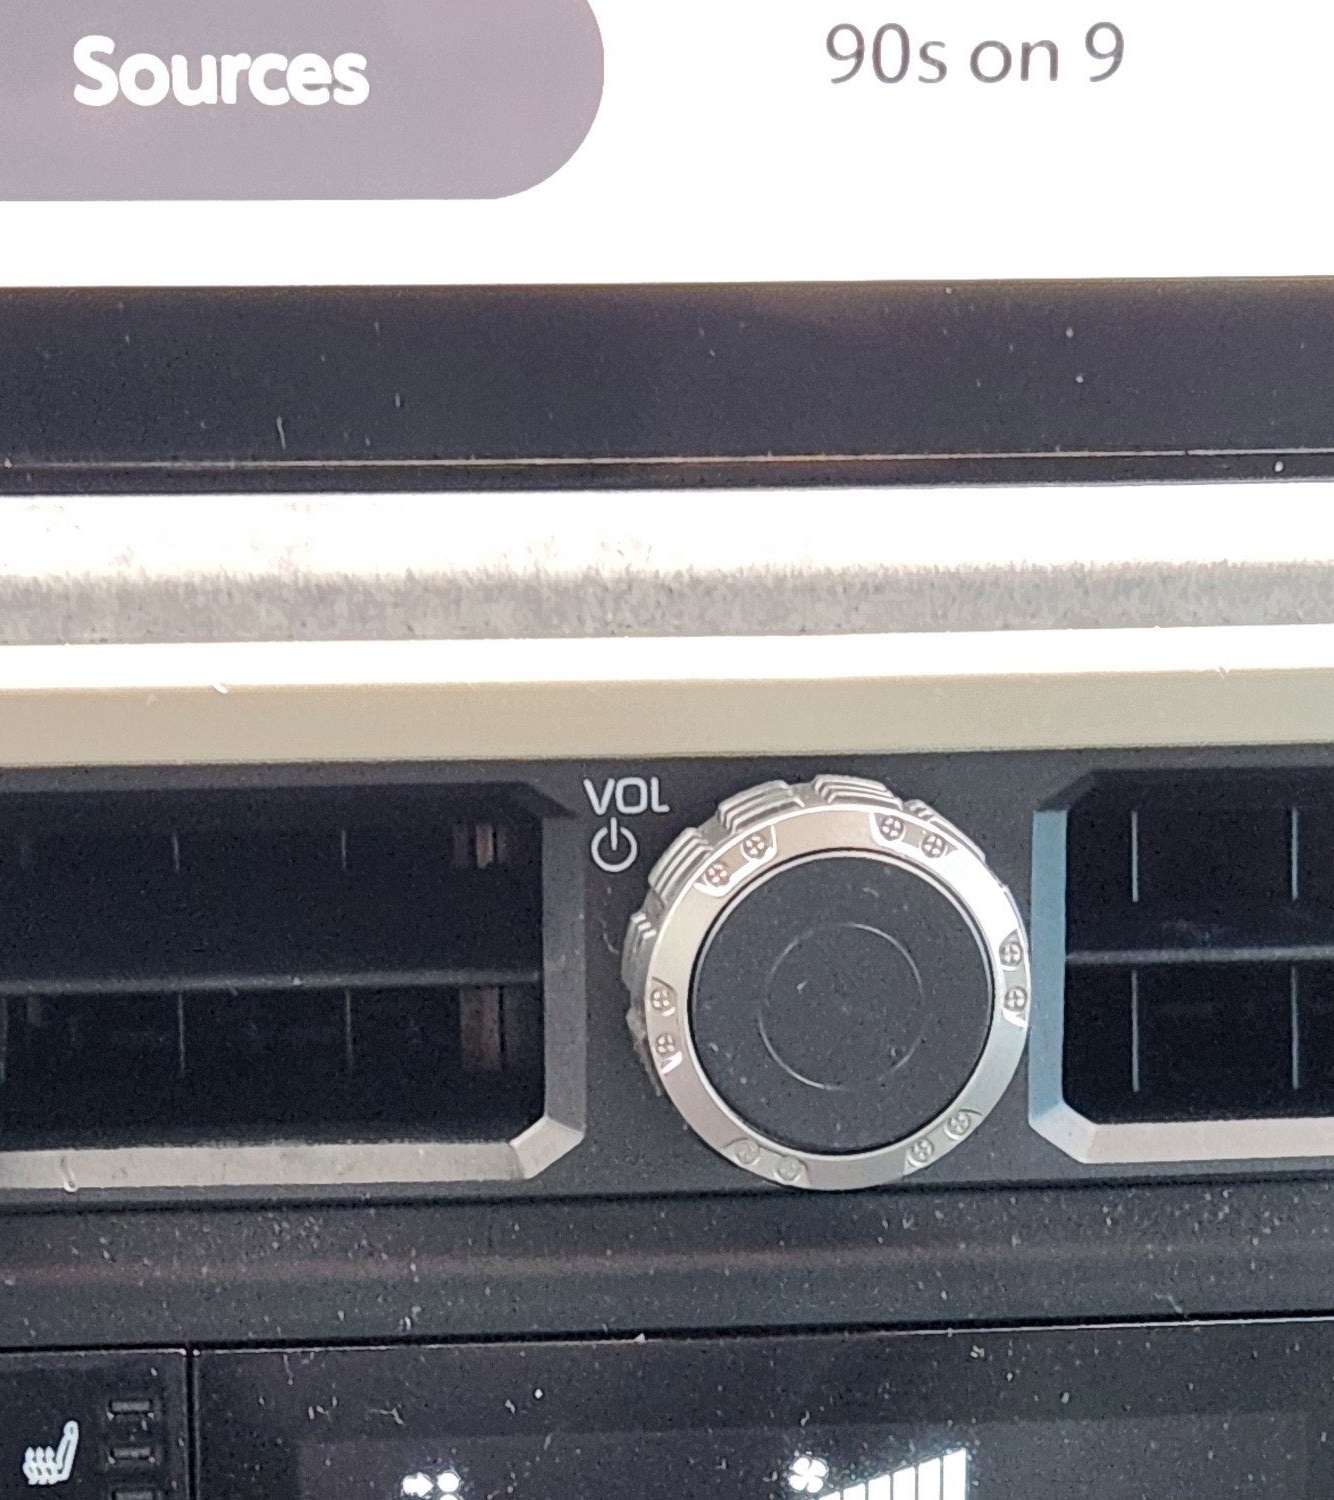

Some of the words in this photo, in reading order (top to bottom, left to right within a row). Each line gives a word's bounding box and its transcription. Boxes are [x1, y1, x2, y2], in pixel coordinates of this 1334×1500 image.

[73, 34, 370, 107] Sources
[826, 22, 948, 85] 90s
[969, 39, 1059, 84] on
[1084, 21, 1125, 83] 9
[583, 776, 670, 816] VOL
